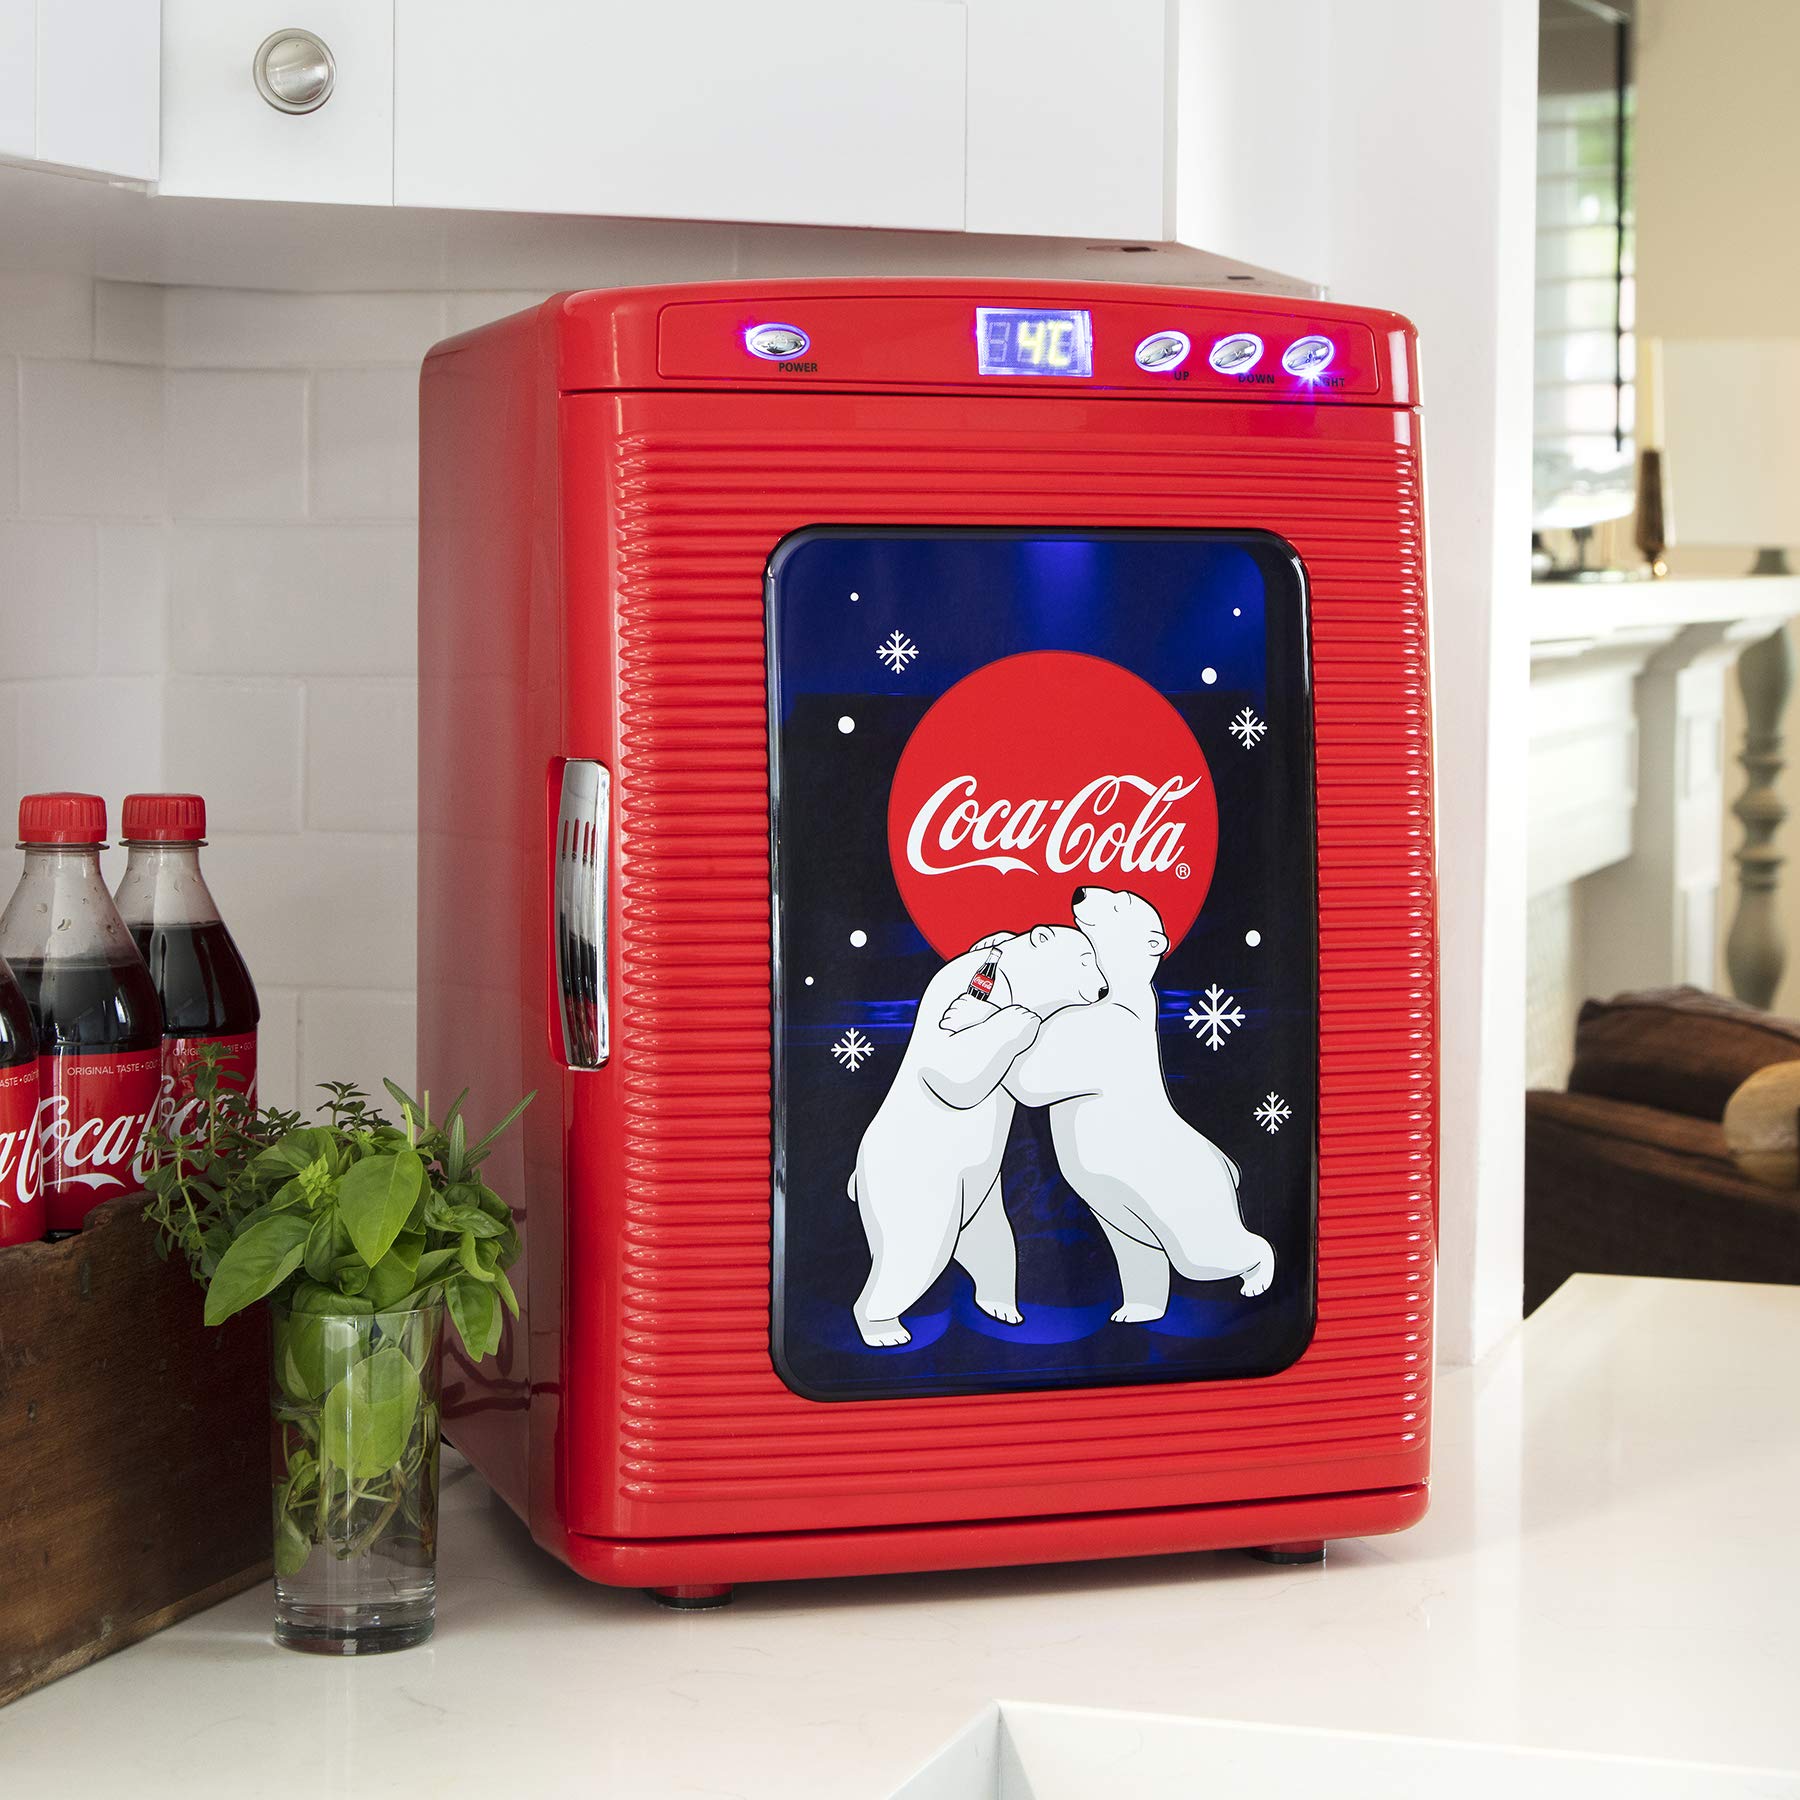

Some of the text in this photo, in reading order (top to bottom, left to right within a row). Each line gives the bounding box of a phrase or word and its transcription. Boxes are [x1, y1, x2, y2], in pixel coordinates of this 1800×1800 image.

[778, 362, 818, 373] POWER
[1173, 371, 1190, 381] UP
[1238, 373, 1275, 385] DOWN
[1312, 377, 1345, 387] LGHT
[906, 774, 1202, 876] Coca-Cola
[66, 1066, 114, 1077] ORIGINAL
[116, 1062, 140, 1074] TASTE
[0, 1076, 18, 1088] ASTE
